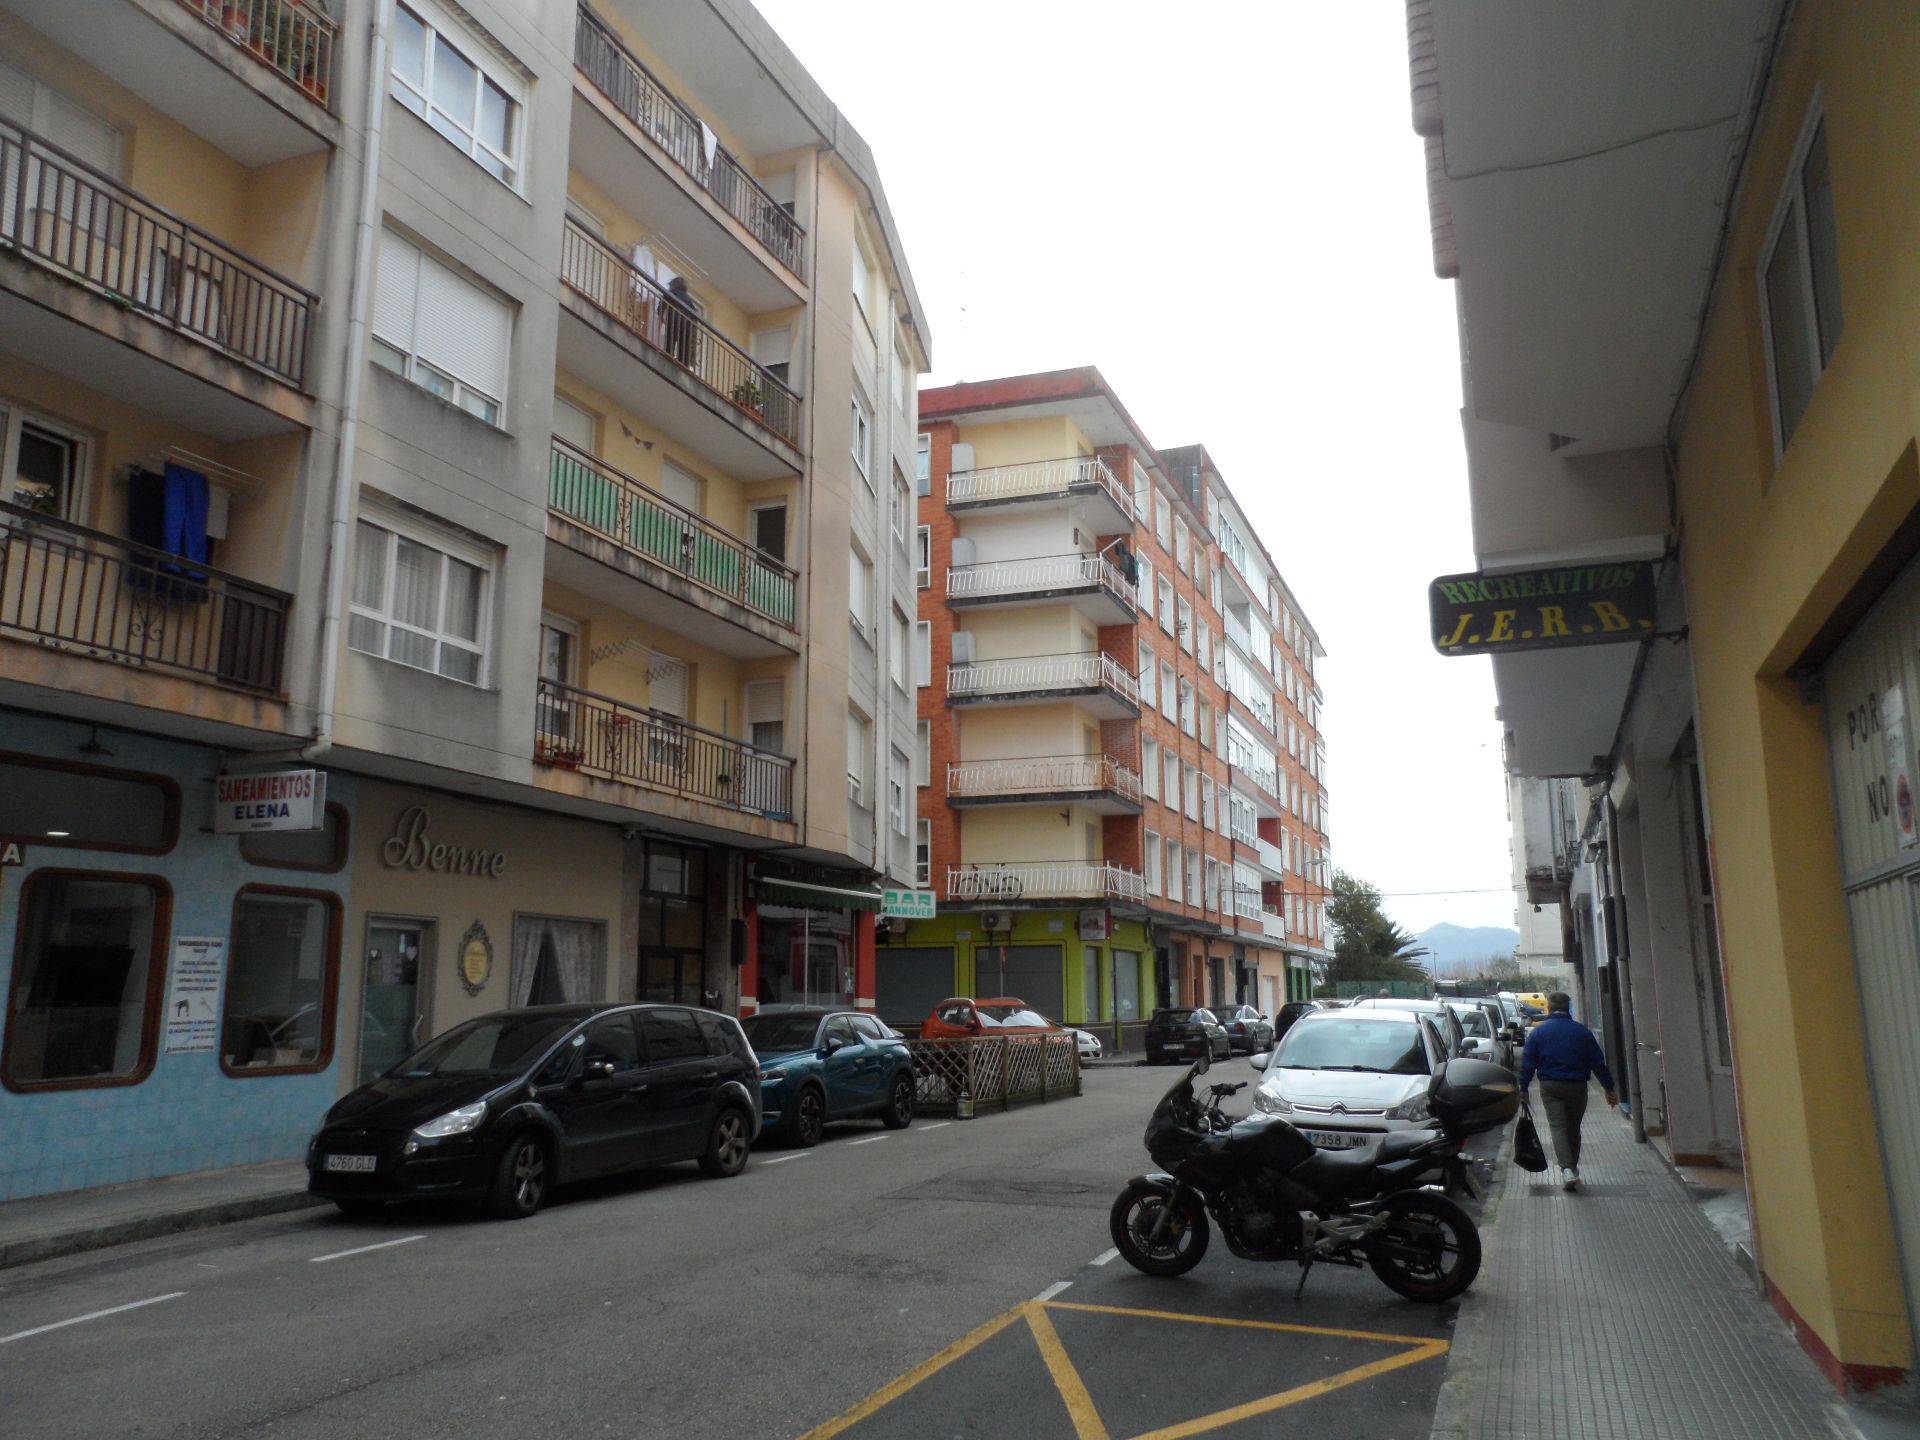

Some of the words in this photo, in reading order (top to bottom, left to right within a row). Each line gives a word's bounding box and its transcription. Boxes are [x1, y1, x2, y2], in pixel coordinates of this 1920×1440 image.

[1437, 564, 1638, 604] RECREATIVOS
[1848, 692, 1880, 750] POR
[218, 774, 312, 803] SANEAMIENTOS
[1867, 775, 1889, 824] NO
[234, 803, 290, 820] ELENA
[384, 806, 506, 877] Benne
[885, 892, 930, 906] BAR
[1313, 1133, 1341, 1146] 7358
[1346, 1137, 1367, 1147] JMN
